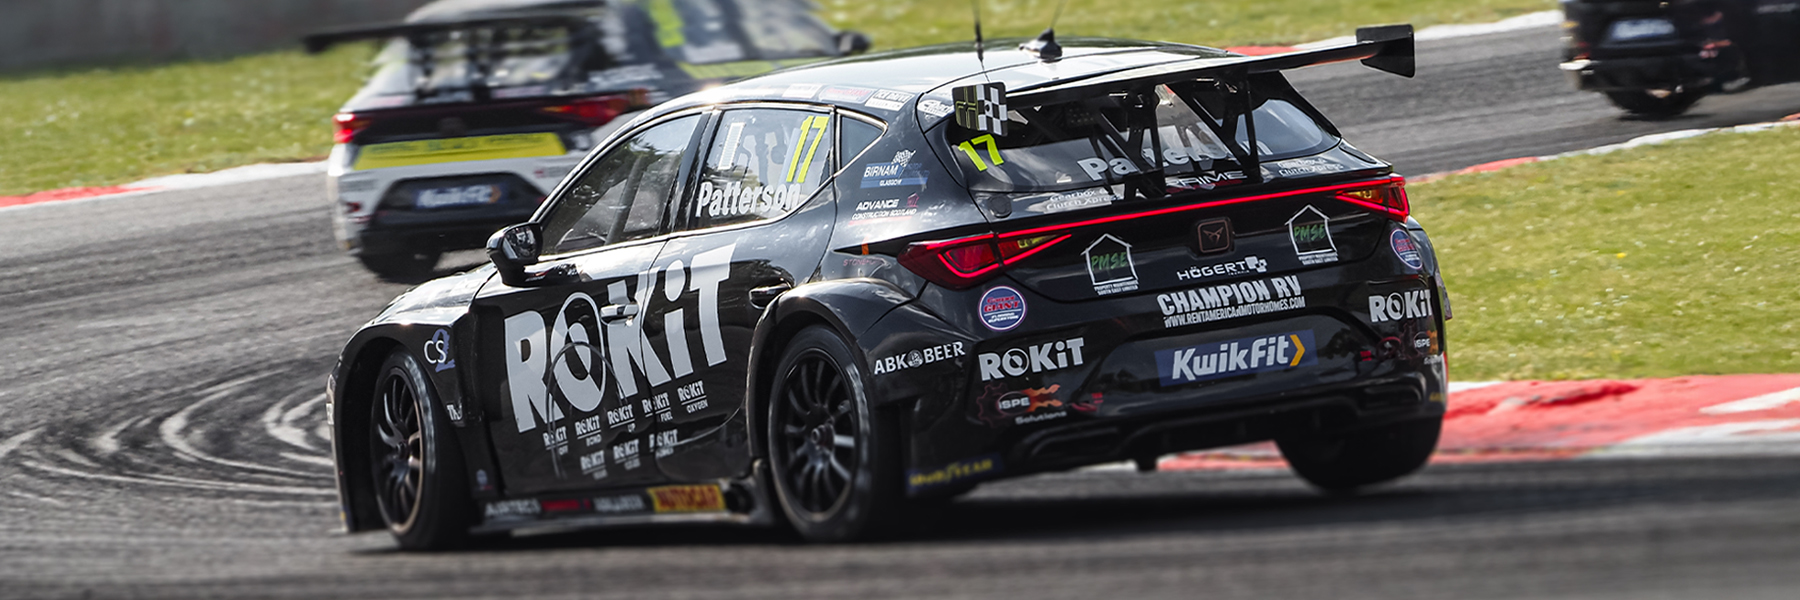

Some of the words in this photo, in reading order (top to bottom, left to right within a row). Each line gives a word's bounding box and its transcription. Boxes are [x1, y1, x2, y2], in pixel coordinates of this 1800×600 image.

[785, 115, 830, 183] 17
[957, 133, 1004, 171] 17
[863, 164, 899, 178] BIRNAM
[695, 180, 801, 218] Patterson
[855, 198, 900, 212] ADVANCE
[1050, 189, 1096, 202] Gearbox
[1293, 222, 1327, 242] PMSE
[1090, 250, 1129, 272] PMSE
[1176, 261, 1246, 281] HÖGERT
[1157, 279, 1271, 316] CHAMPION
[1270, 275, 1302, 299] RV
[873, 354, 909, 375] ABK
[923, 341, 966, 364] BEER
[978, 337, 1085, 381] ROKiT
[1172, 335, 1290, 381] KwikFit
[686, 399, 709, 414] OXYGEN
[998, 397, 1031, 410] ISPE
